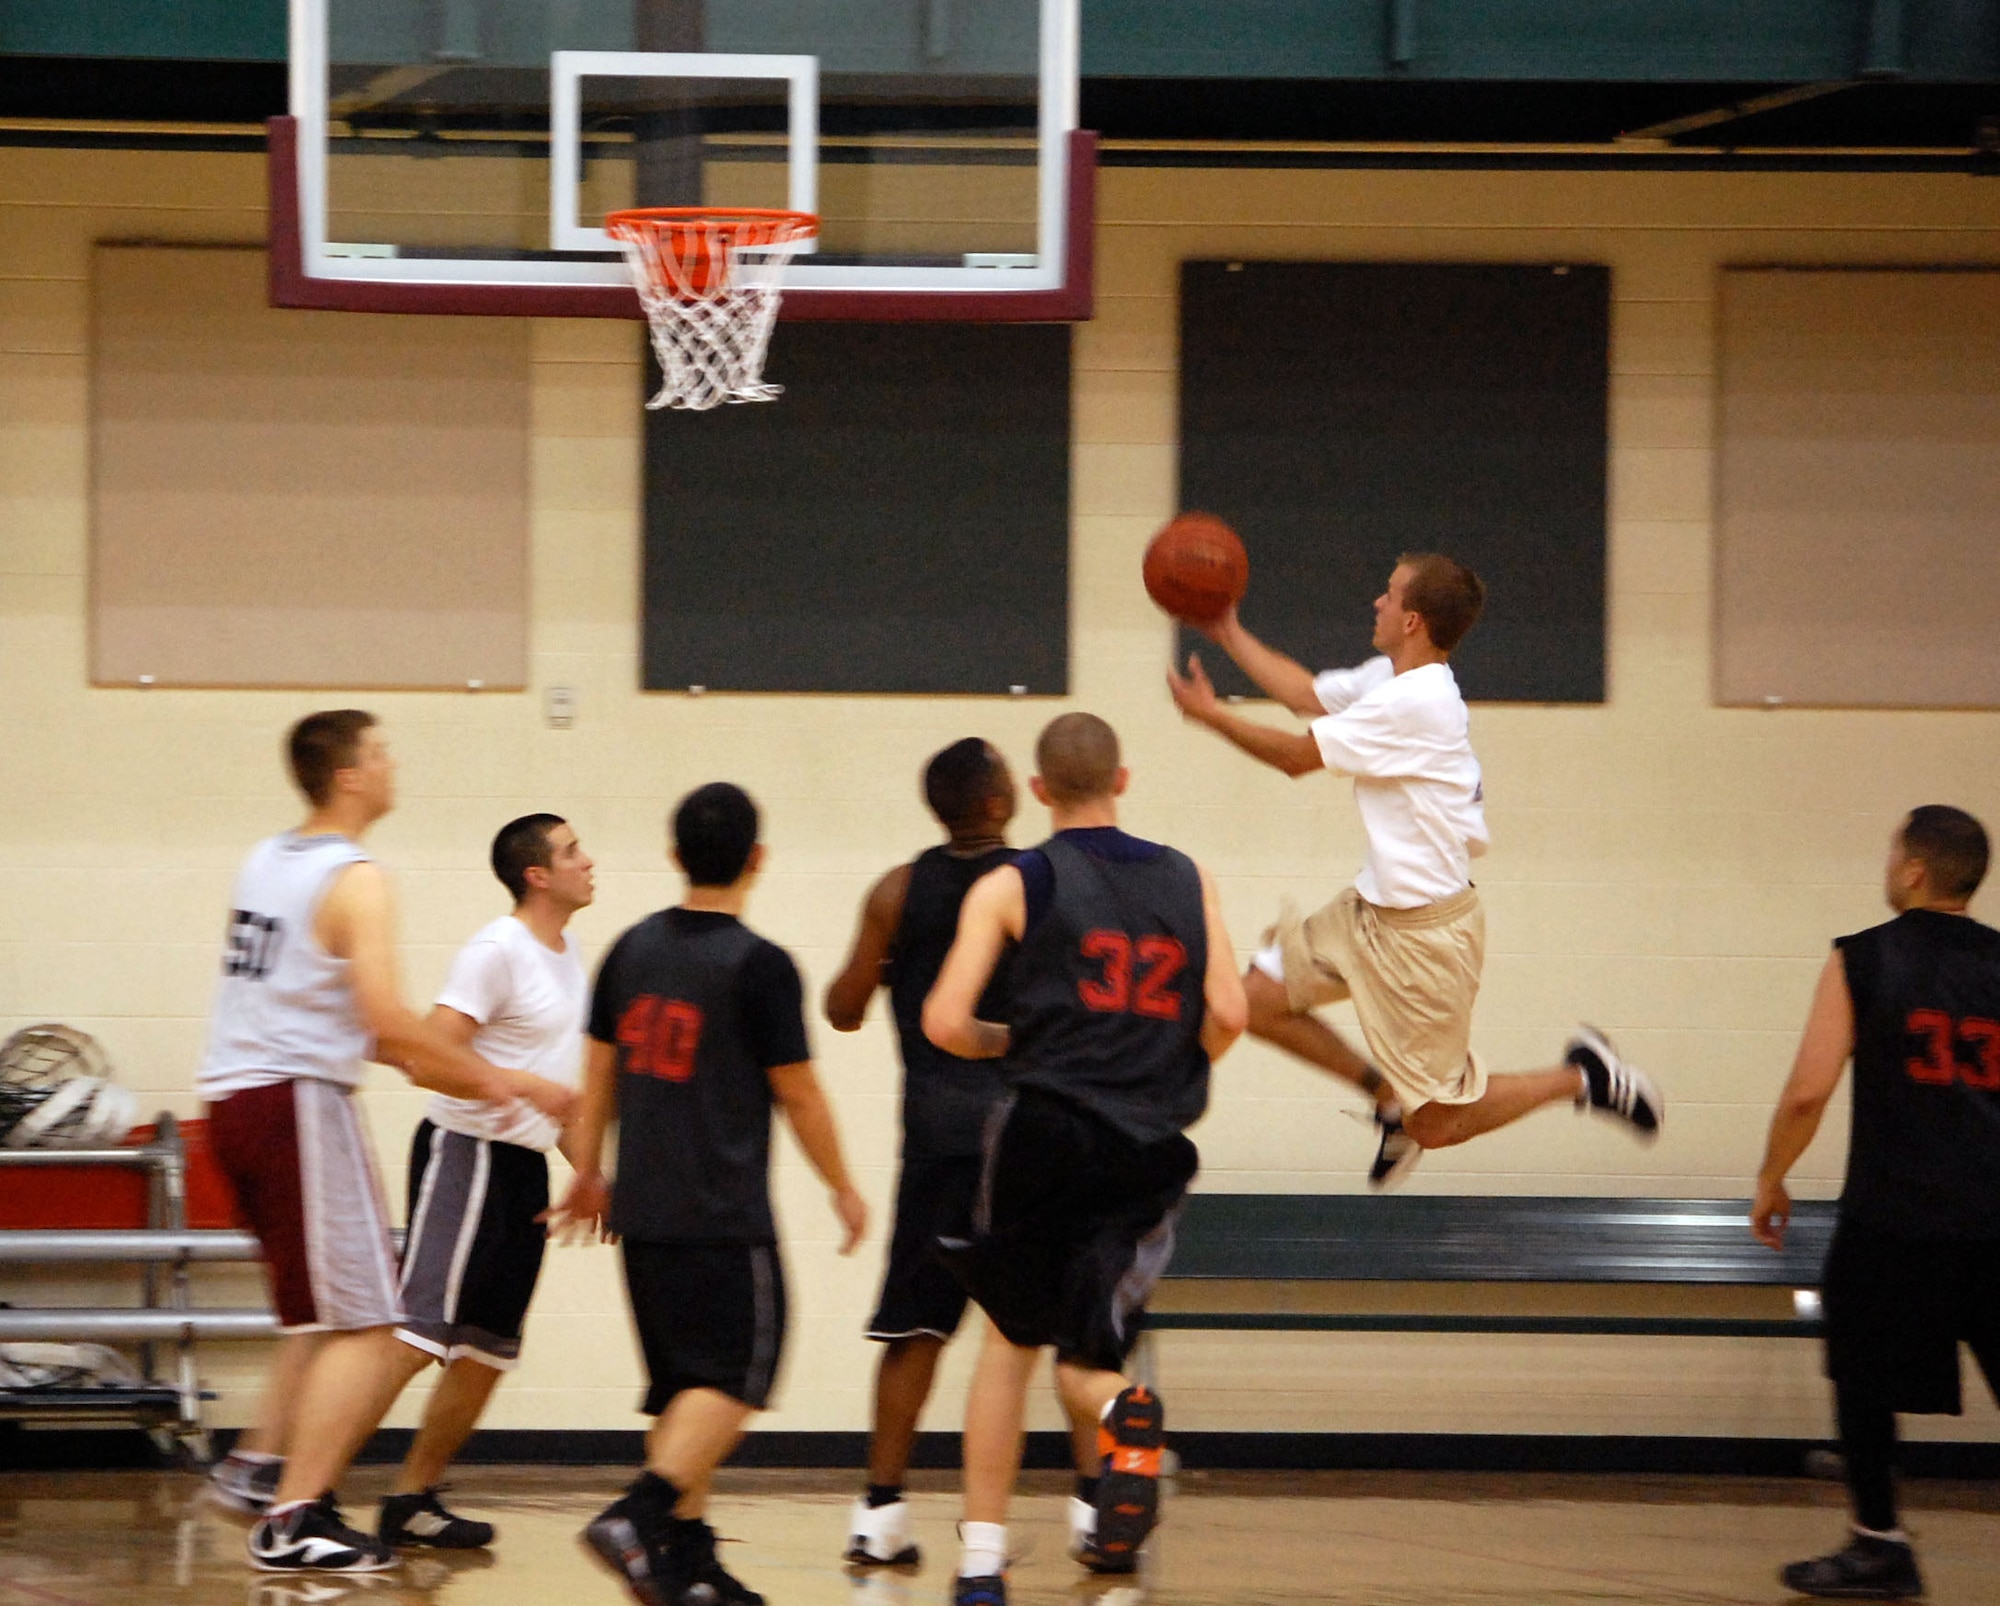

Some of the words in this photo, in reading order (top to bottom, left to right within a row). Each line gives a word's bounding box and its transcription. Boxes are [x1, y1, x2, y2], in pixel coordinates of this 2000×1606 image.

[1079, 927, 1187, 1020] 32
[615, 993, 703, 1082] 40
[1905, 1008, 2000, 1091] 33
